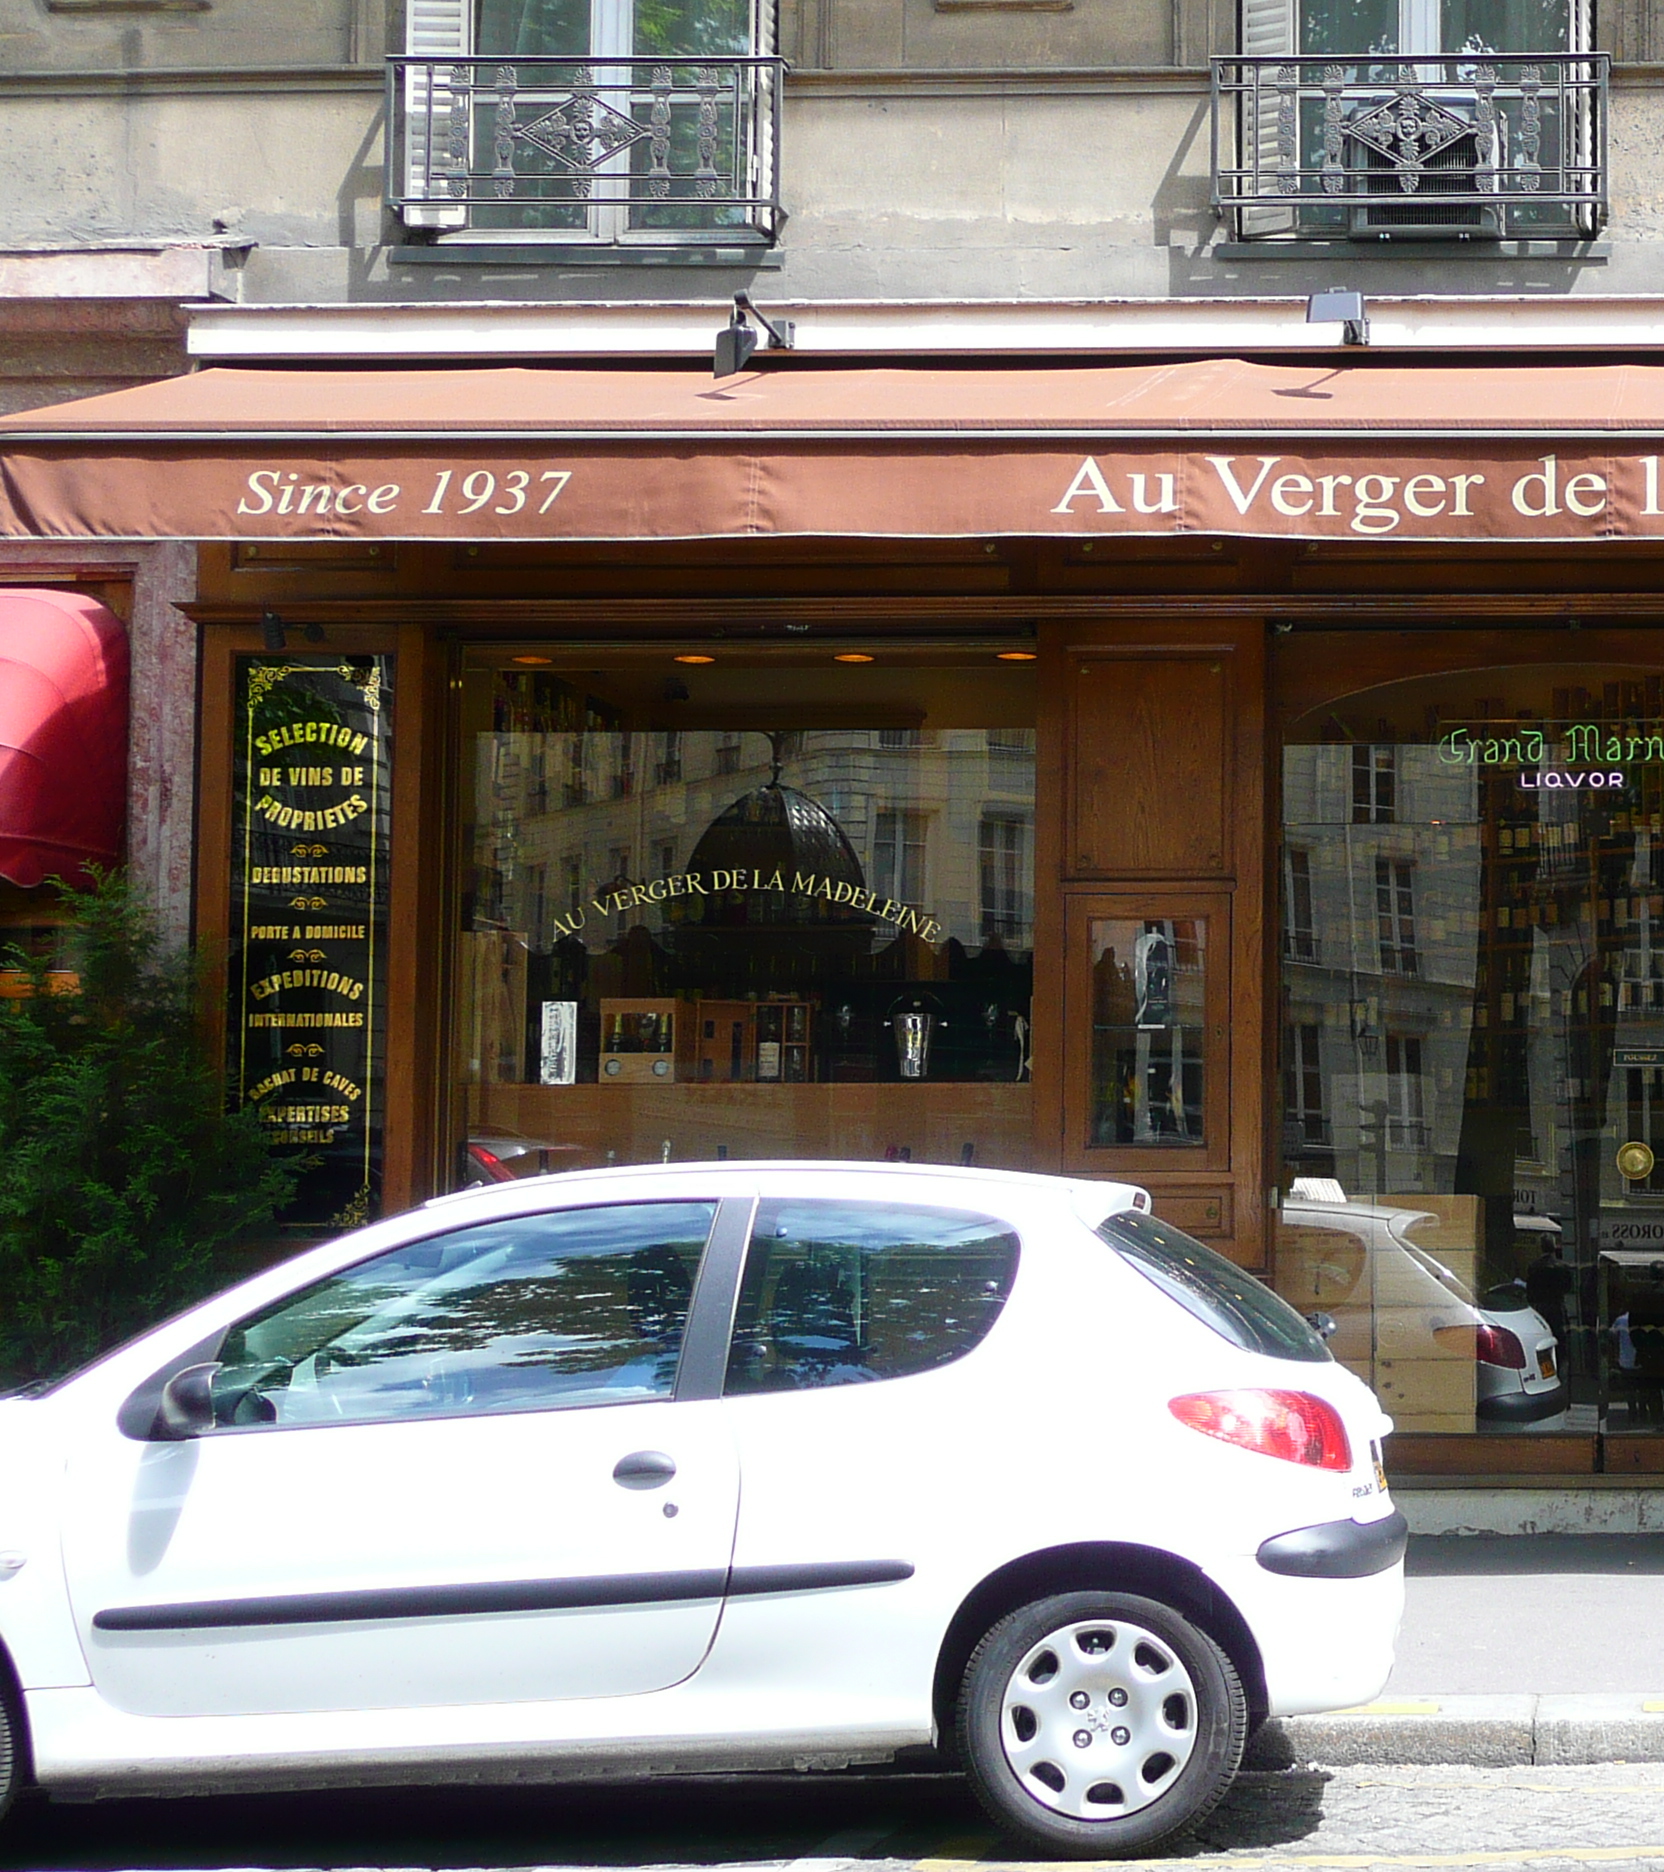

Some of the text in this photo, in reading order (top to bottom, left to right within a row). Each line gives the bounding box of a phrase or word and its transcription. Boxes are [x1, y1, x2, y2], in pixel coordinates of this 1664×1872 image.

[236, 469, 573, 515] Since 1937
[1049, 455, 1182, 515] Au
[1203, 456, 1486, 534] Verger
[1510, 453, 1608, 518] de
[254, 721, 369, 756] SELECTION
[1437, 728, 1544, 764] Grand
[259, 766, 364, 787] DE VINS DE
[254, 794, 368, 831] PROPRIETES
[252, 866, 367, 884] DEGUSTATIONS
[551, 868, 942, 944] AU VERGER DE LA MADELEINE
[250, 925, 366, 939] PORTE A DOMICILE
[250, 969, 364, 1001] EXPEDITIONS
[248, 1012, 364, 1028] INTERNATIONALES
[248, 1066, 362, 1101] RACHAT DE CAVES
